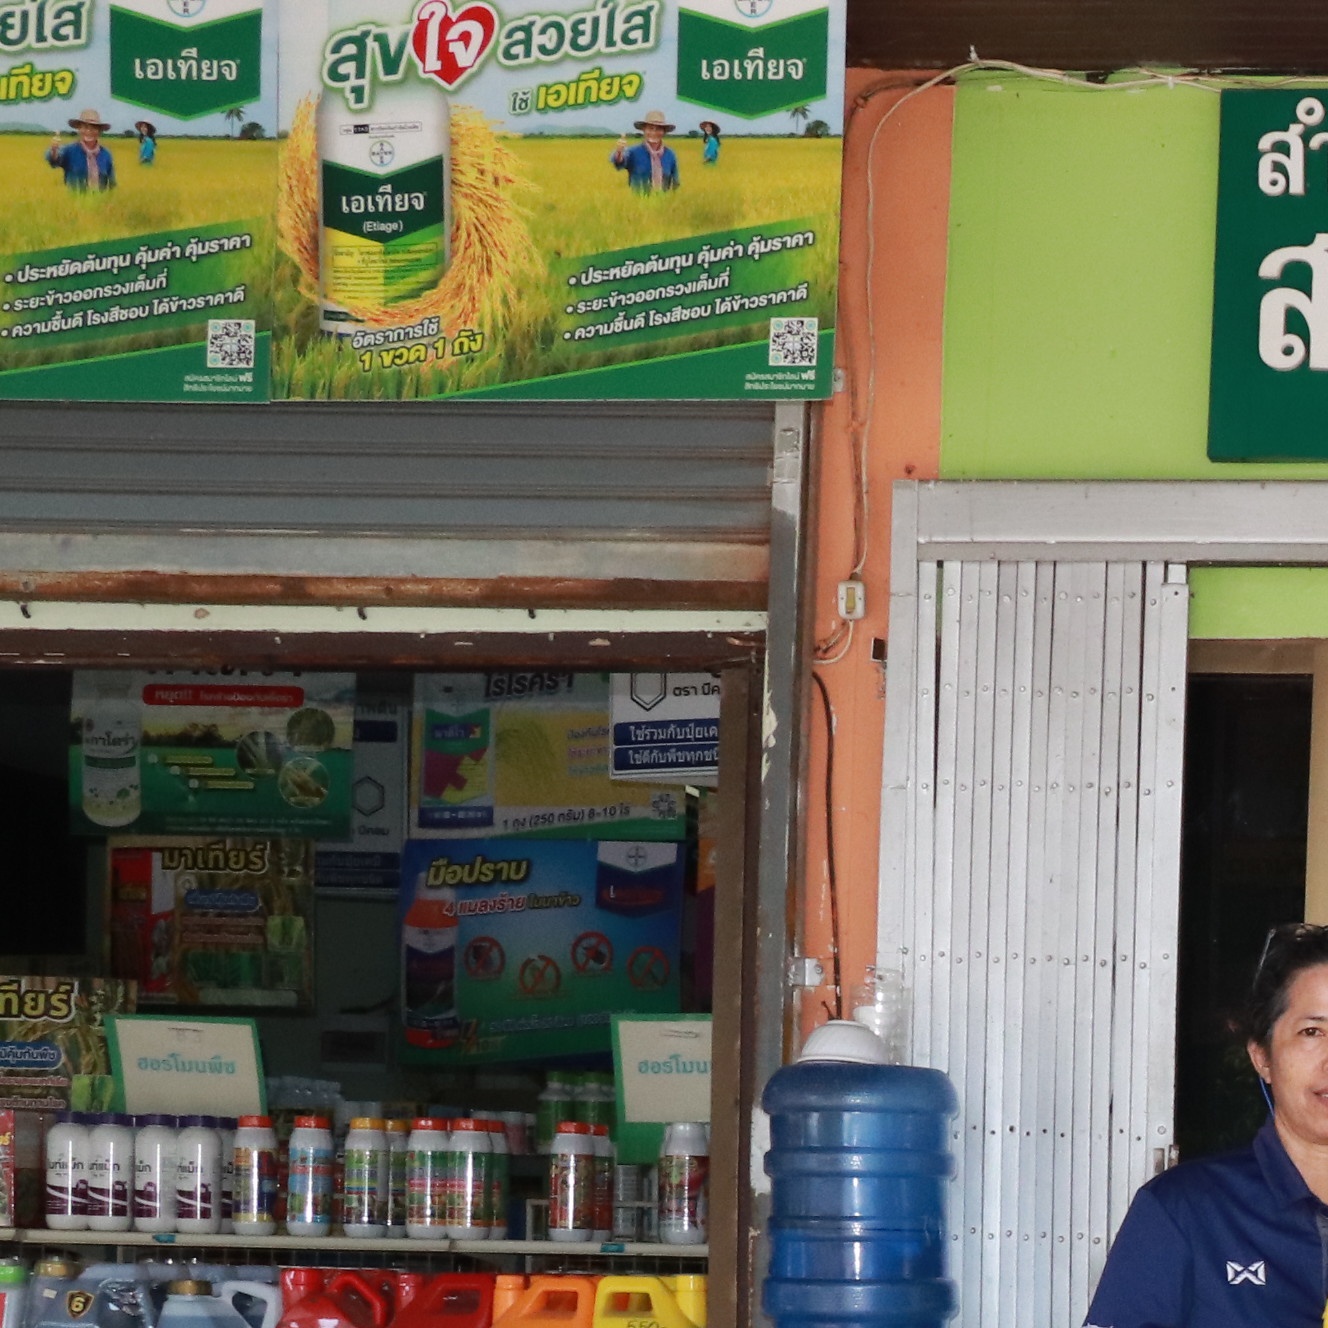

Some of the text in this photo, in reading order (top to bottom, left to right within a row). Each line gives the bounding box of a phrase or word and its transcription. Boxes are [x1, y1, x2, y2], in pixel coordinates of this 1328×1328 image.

[135, 48, 238, 81] เอเทียจ
[701, 48, 804, 81] เอเทียจ
[510, 68, 641, 112] ใช้ เอเทียจ
[341, 185, 425, 214] เอเทียจ
[363, 220, 404, 233] (Etiage)
[17, 233, 251, 283] ประหยัดต้นทุน คุ้มค่า คุ้มราคา
[580, 230, 814, 286] ประหยัดต้นทุน คุ้มค่า คุ้มราคา
[11, 310, 83, 338] ความชื้นดี
[352, 316, 440, 349] อัตราการใช้
[574, 310, 645, 340] ความชื้นดี
[360, 351, 371, 371] 1
[434, 338, 445, 359] 1
[161, 840, 269, 872] มาเทียร์
[426, 855, 531, 888] มือปราบ
[71, 1296, 84, 1312] 6
